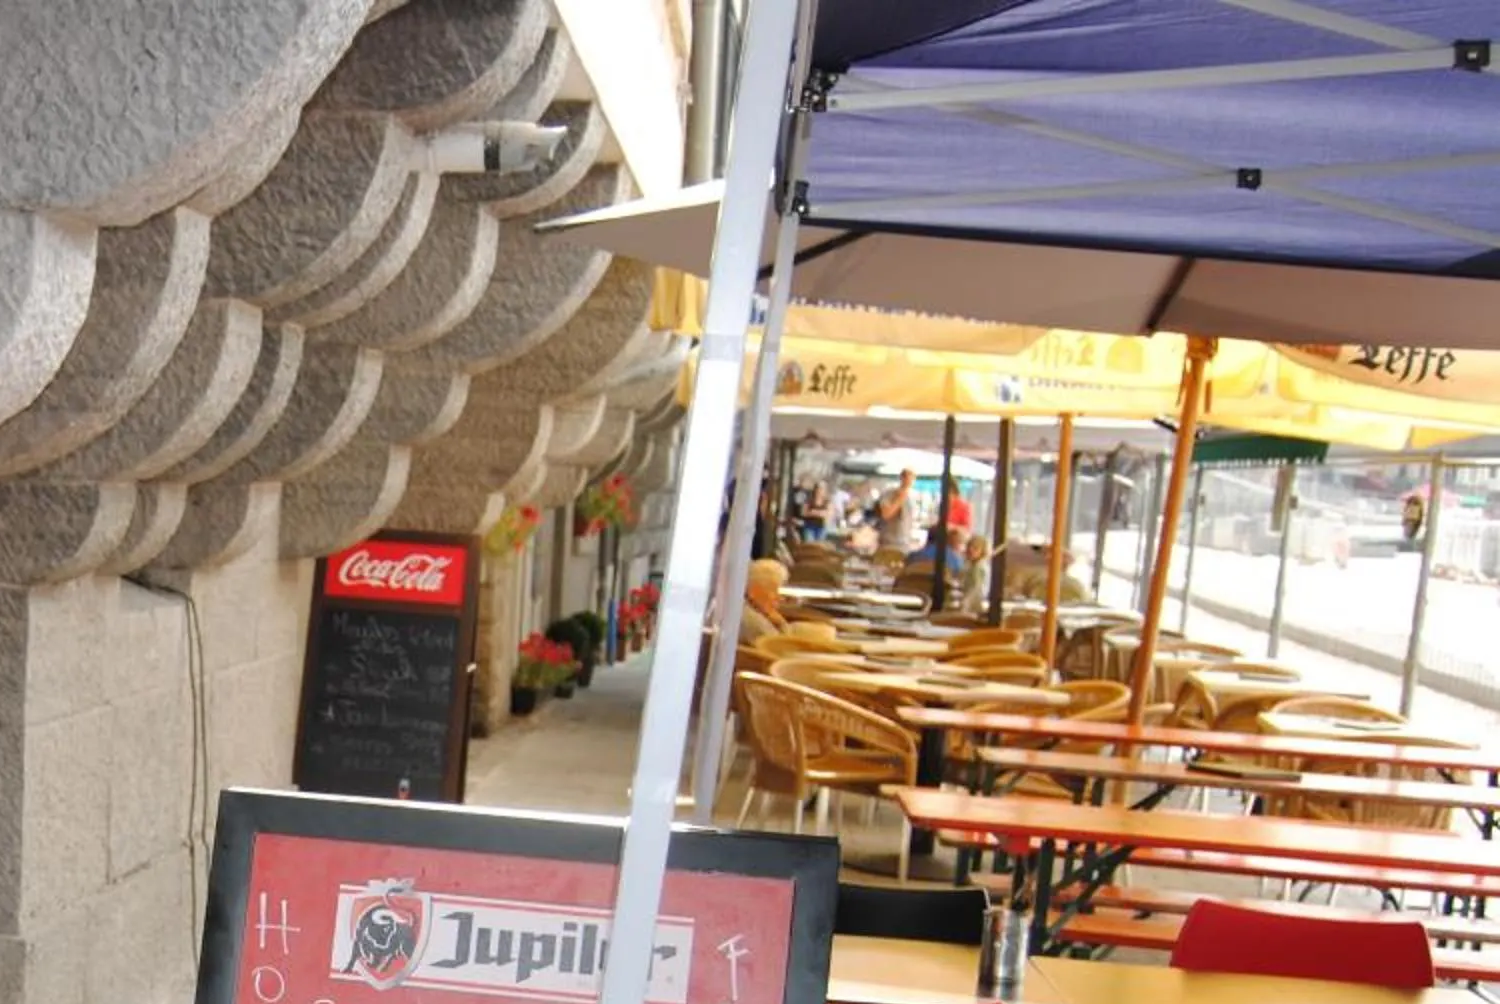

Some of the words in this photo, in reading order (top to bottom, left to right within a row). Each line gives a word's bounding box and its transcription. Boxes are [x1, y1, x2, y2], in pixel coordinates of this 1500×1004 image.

[808, 362, 857, 400] Leffe
[1348, 345, 1457, 384] Leffe
[339, 549, 453, 592] Coca-Cola
[430, 911, 678, 984] Jupilr
